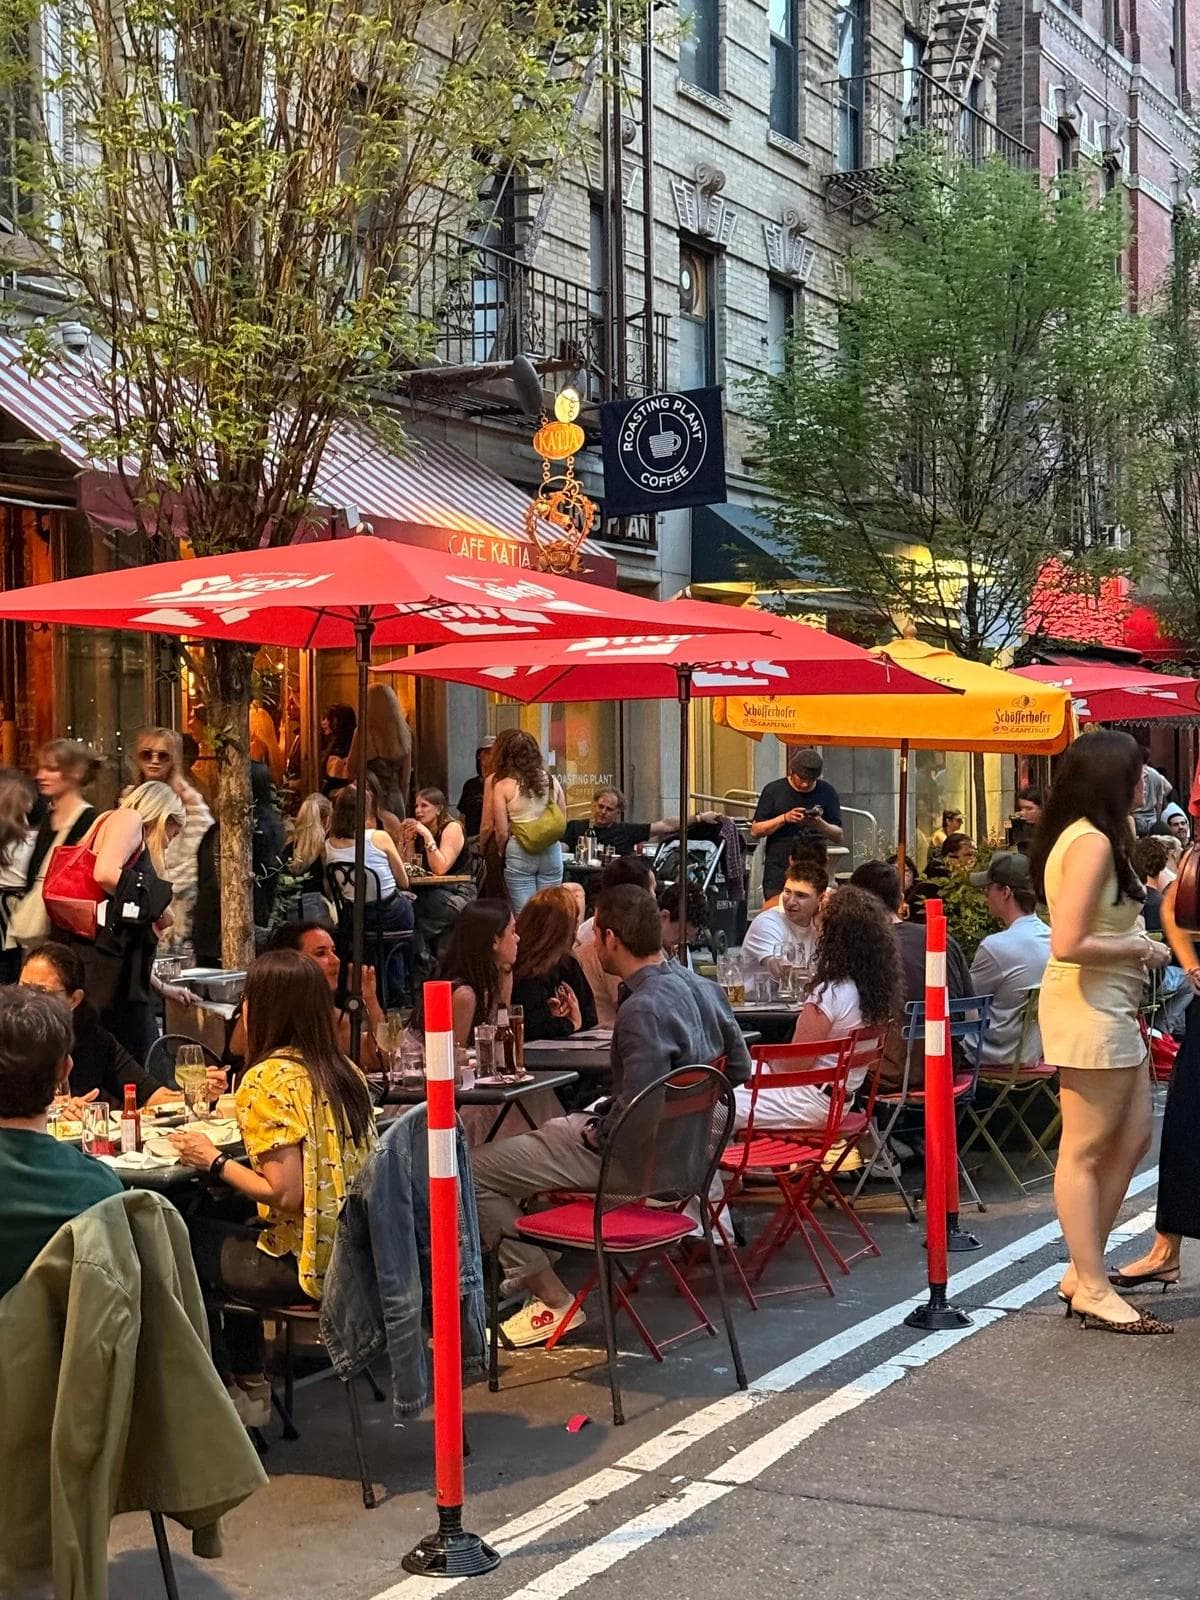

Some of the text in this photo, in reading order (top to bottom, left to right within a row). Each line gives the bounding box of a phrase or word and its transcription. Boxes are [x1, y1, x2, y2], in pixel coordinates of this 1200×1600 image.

[623, 398, 702, 452] ROASTING PLANT
[640, 465, 689, 488] COFFEE
[449, 534, 487, 561] CAFE
[589, 774, 614, 785] PLANT
